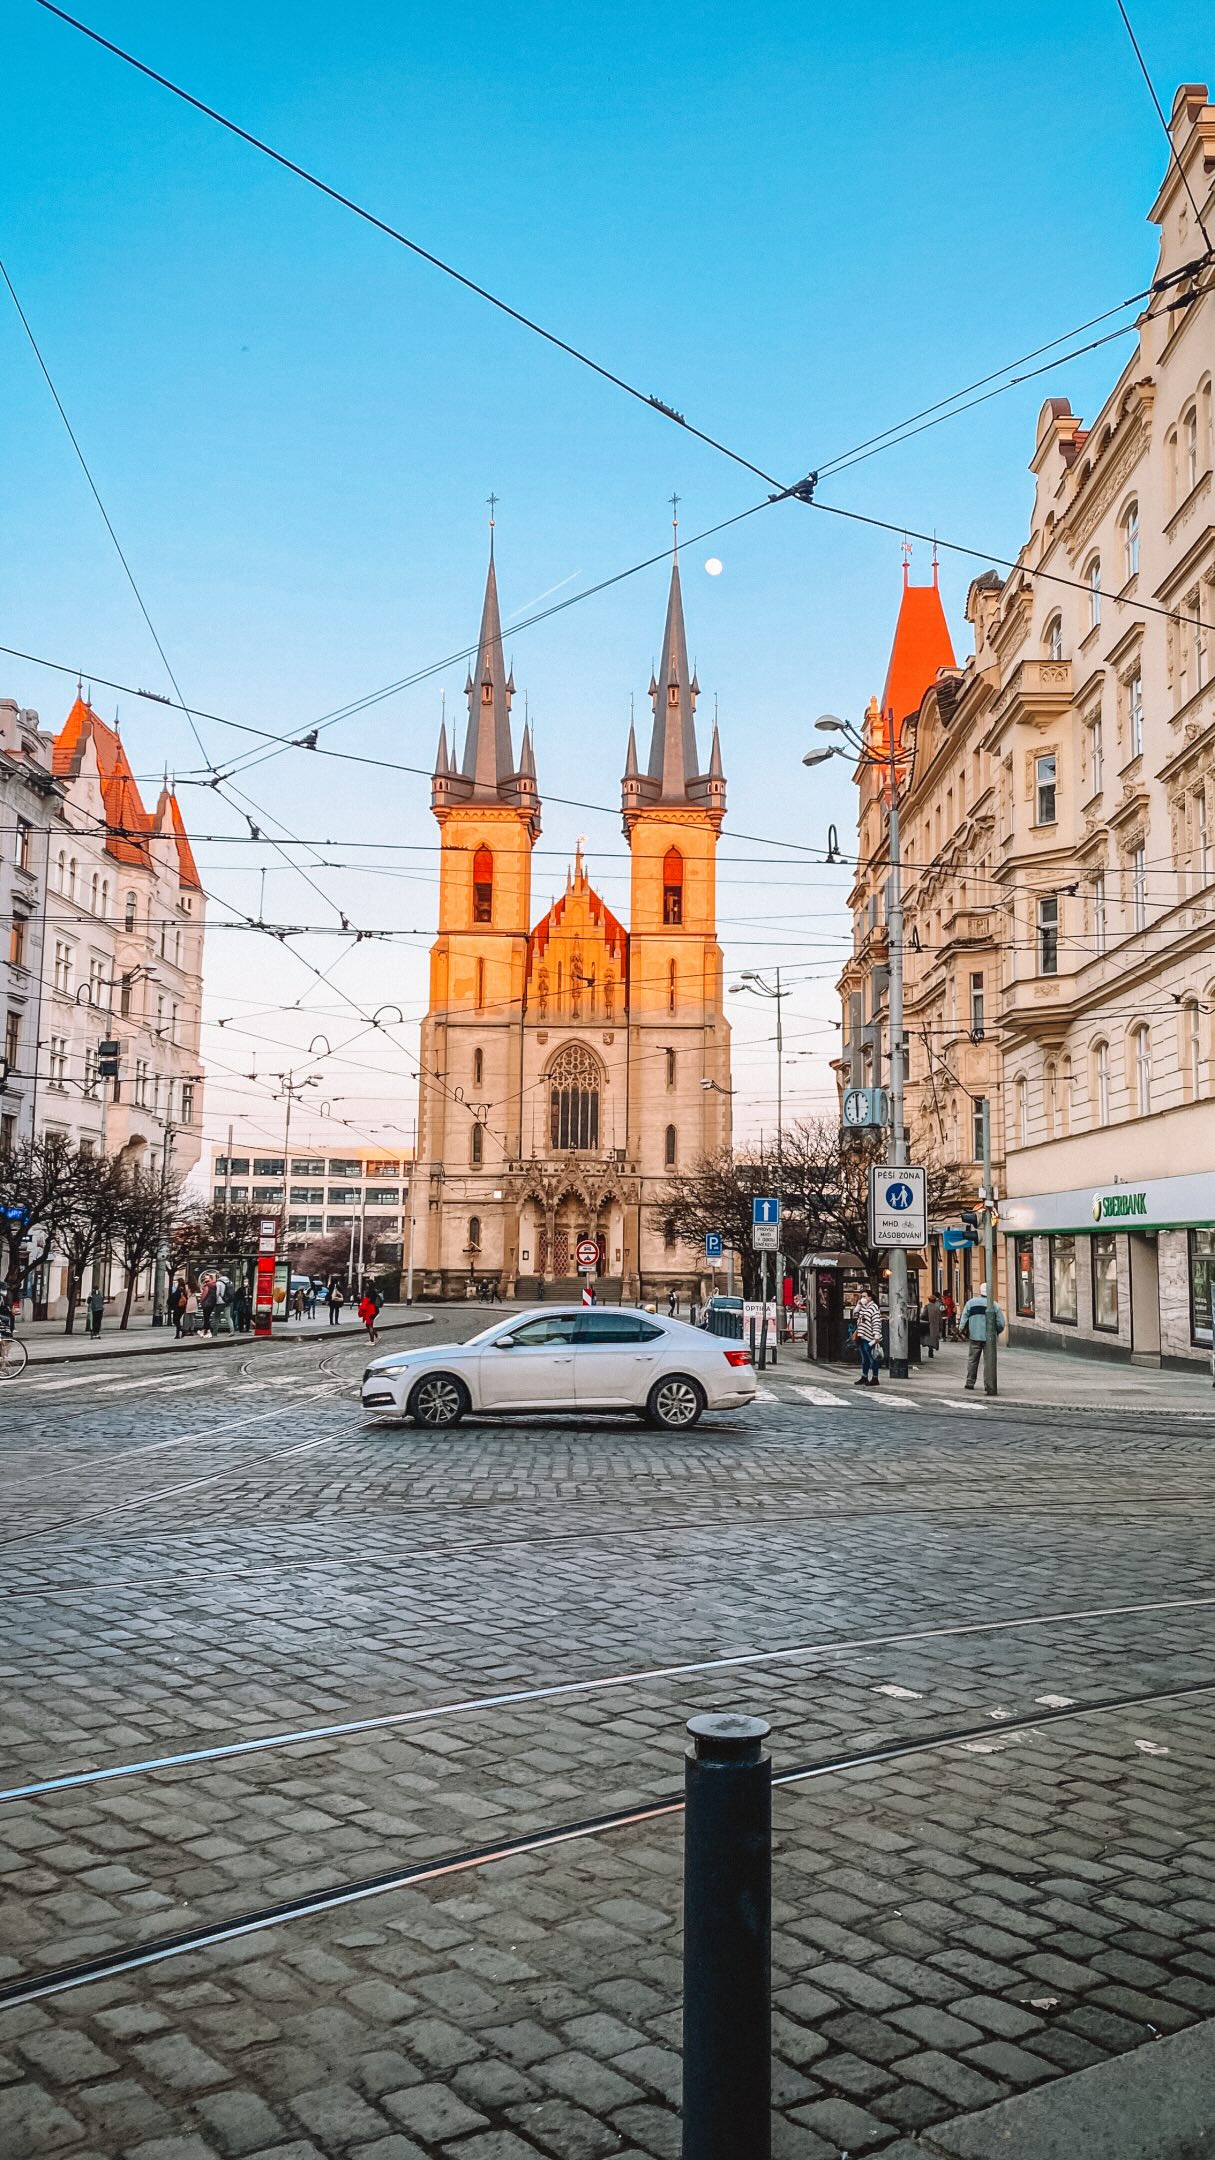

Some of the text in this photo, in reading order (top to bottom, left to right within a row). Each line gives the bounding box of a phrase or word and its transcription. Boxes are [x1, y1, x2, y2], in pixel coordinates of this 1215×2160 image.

[898, 1171, 920, 1179] ZÓNA
[1102, 1193, 1146, 1217] SBERBANK
[878, 1231, 922, 1239] ZÁSOBOVÁNÍ
